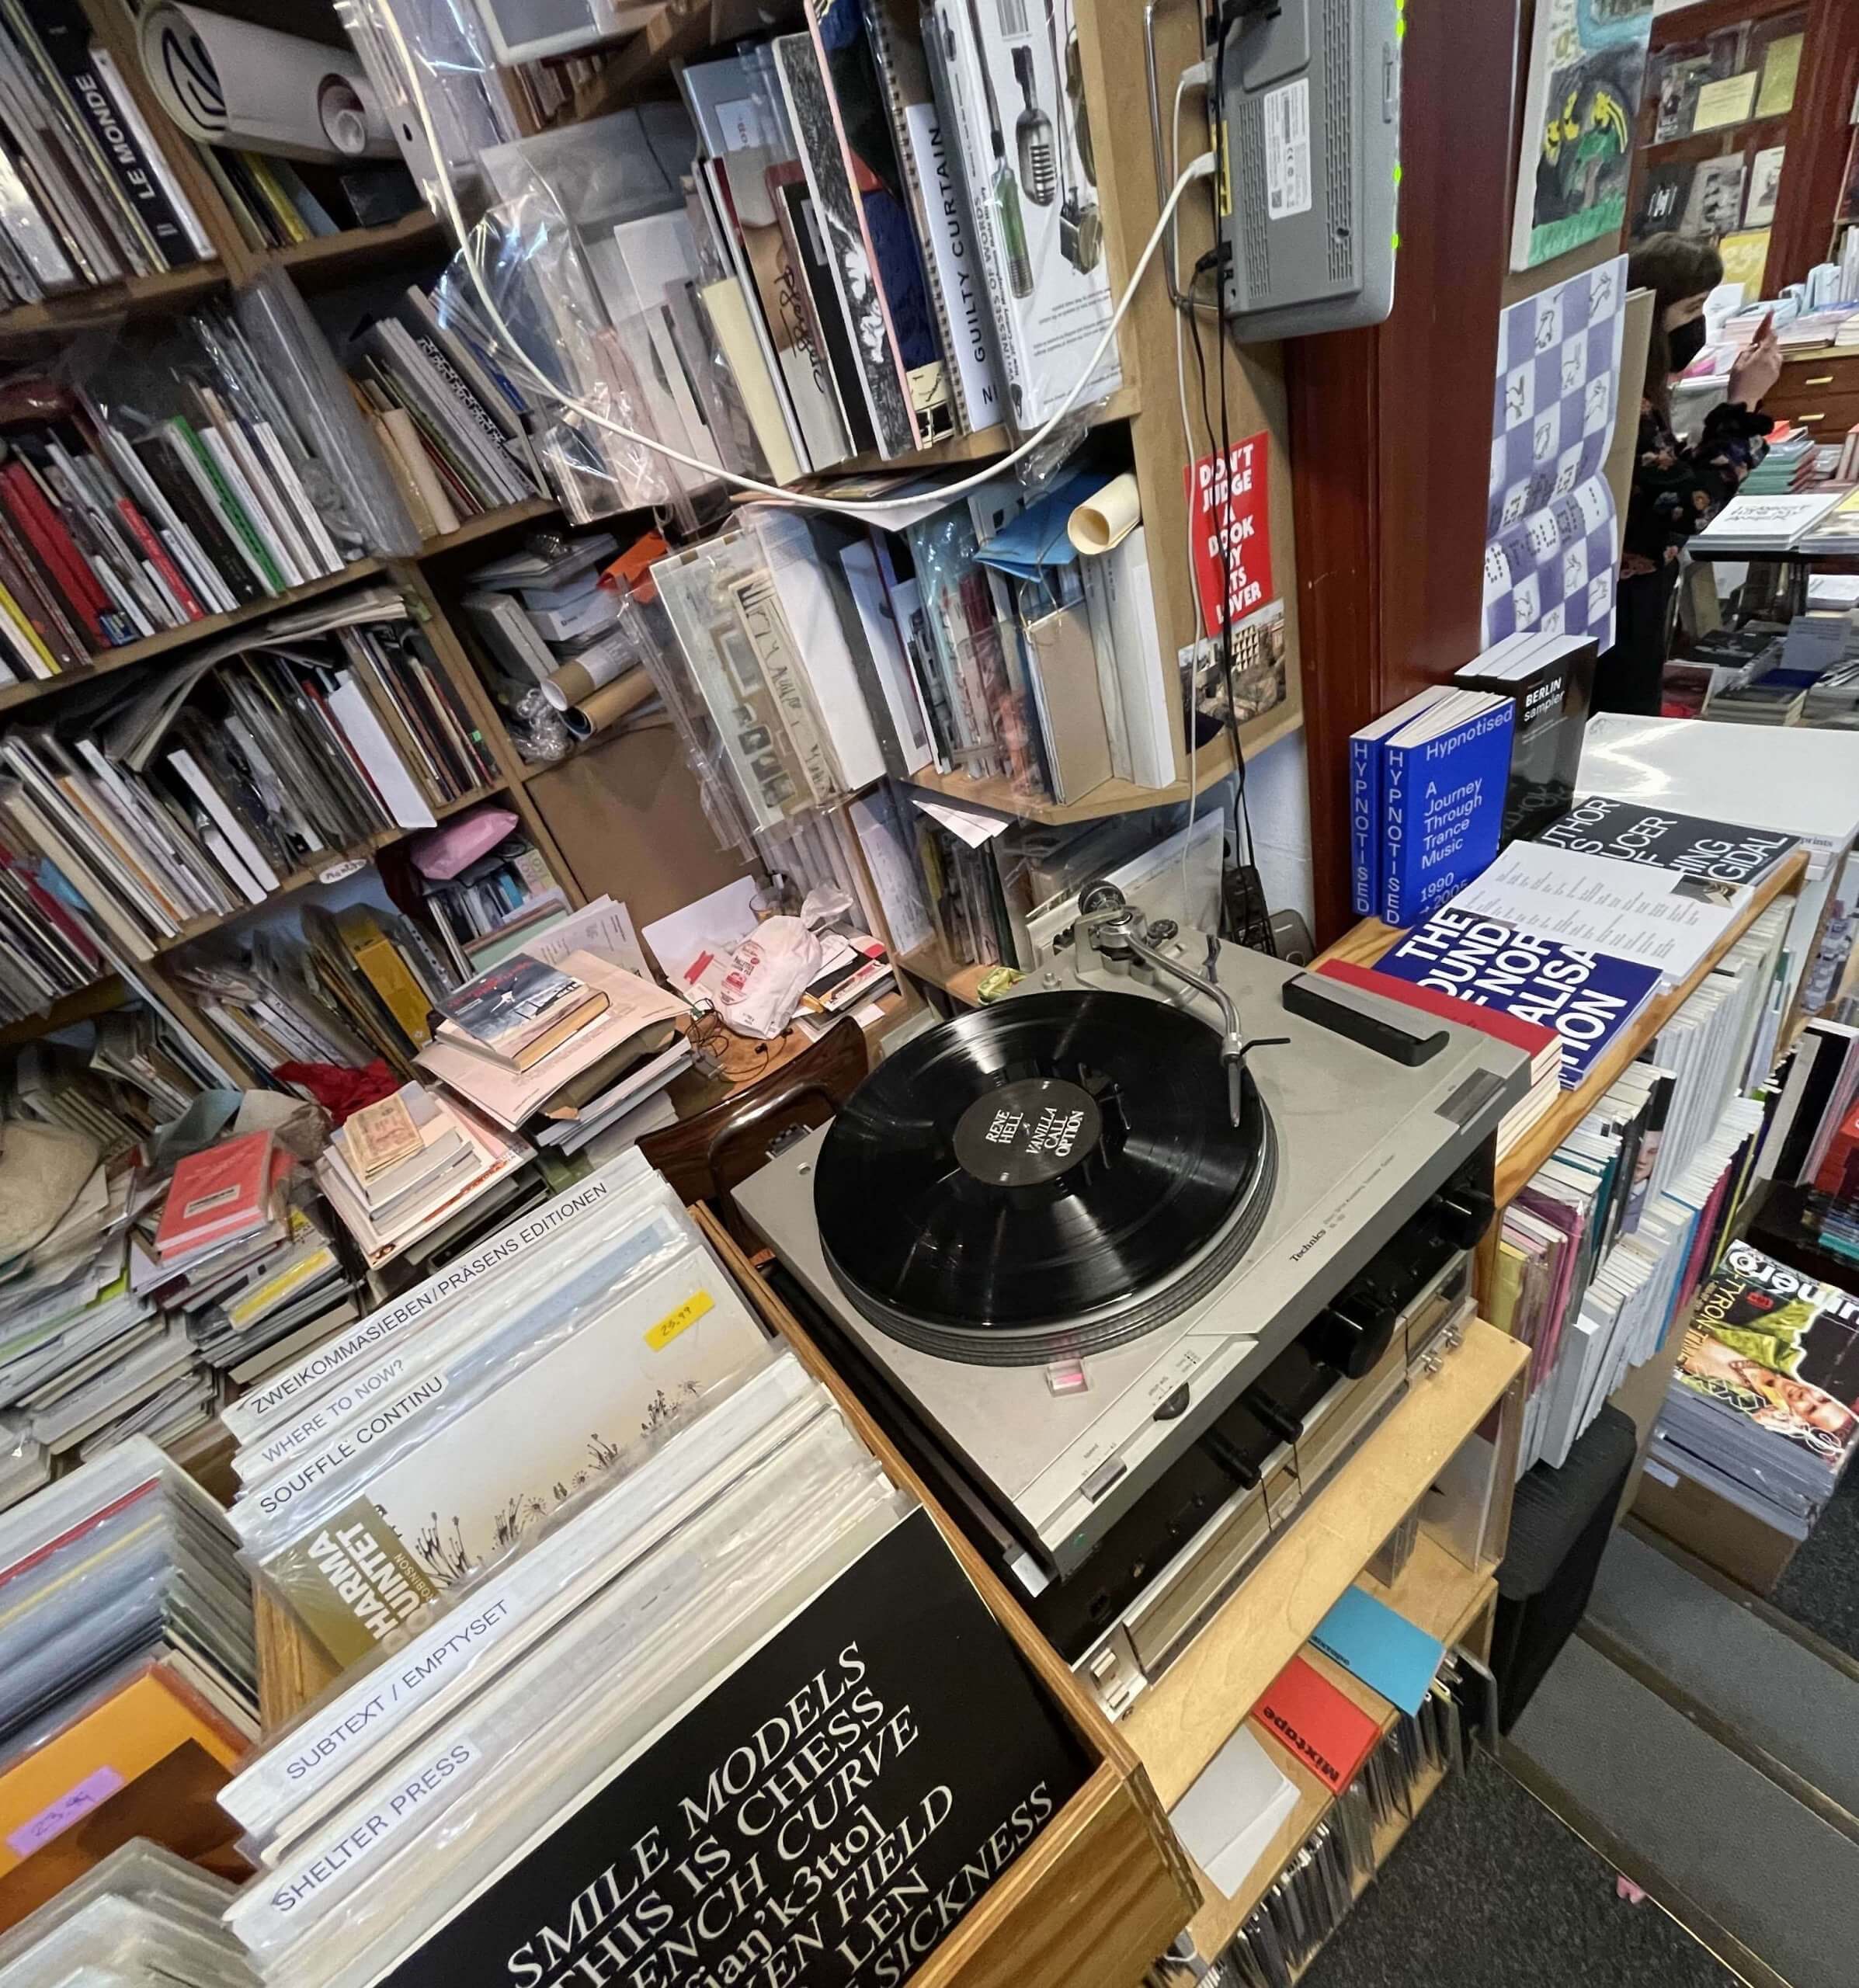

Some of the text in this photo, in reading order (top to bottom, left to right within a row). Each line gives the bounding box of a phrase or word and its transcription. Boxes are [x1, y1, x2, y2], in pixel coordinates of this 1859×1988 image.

[76, 71, 154, 200] LE MONDE
[929, 128, 965, 257] CURTAIN
[971, 196, 992, 262] WORDS
[958, 271, 986, 363] GUILTY
[1200, 443, 1254, 488] DON'T
[1203, 468, 1253, 513] JUDGE
[1222, 503, 1236, 526] A
[1524, 690, 1565, 722] sampler
[1525, 676, 1562, 708] BERLIN
[1426, 705, 1513, 762] Hypnotised
[1423, 777, 1482, 817] Journey
[1423, 794, 1482, 834] Through
[1425, 780, 1437, 799] A
[1353, 742, 1370, 913] HYPNOTISED
[1386, 751, 1404, 925] HYPNOTISED
[1421, 837, 1464, 870] Music
[1423, 818, 1471, 851] Trance
[1708, 836, 1788, 882] GIDAL
[1420, 872, 1454, 902] 1990
[1395, 909, 1476, 961] THE
[985, 1109, 1010, 1143] RENE
[999, 1111, 1023, 1144] HELL
[1026, 1107, 1058, 1155] VANILLA
[1044, 1115, 1068, 1149] CALL
[1055, 1110, 1085, 1157] OPTION
[522, 1181, 608, 1244] EDITIONEN
[1289, 1229, 1326, 1263] Technics
[262, 1359, 406, 1464] WHERE TO NOW?
[260, 1376, 444, 1514] SOUFFLE CONTINU
[286, 1599, 509, 1780] SUBTEXT / EMPTYSET
[1263, 1705, 1340, 1784] Mixtape
[674, 1836, 732, 1899] IS
[736, 1687, 885, 1838] CHESS
[777, 1705, 920, 1862] CURVE
[273, 1743, 471, 1913] SHELTER PRESS
[507, 1640, 867, 1988] SMILE MODELS
[832, 1784, 954, 1920] FIELD
[875, 1781, 1054, 1988] SICKNESS
[835, 1863, 932, 1974] LEN
